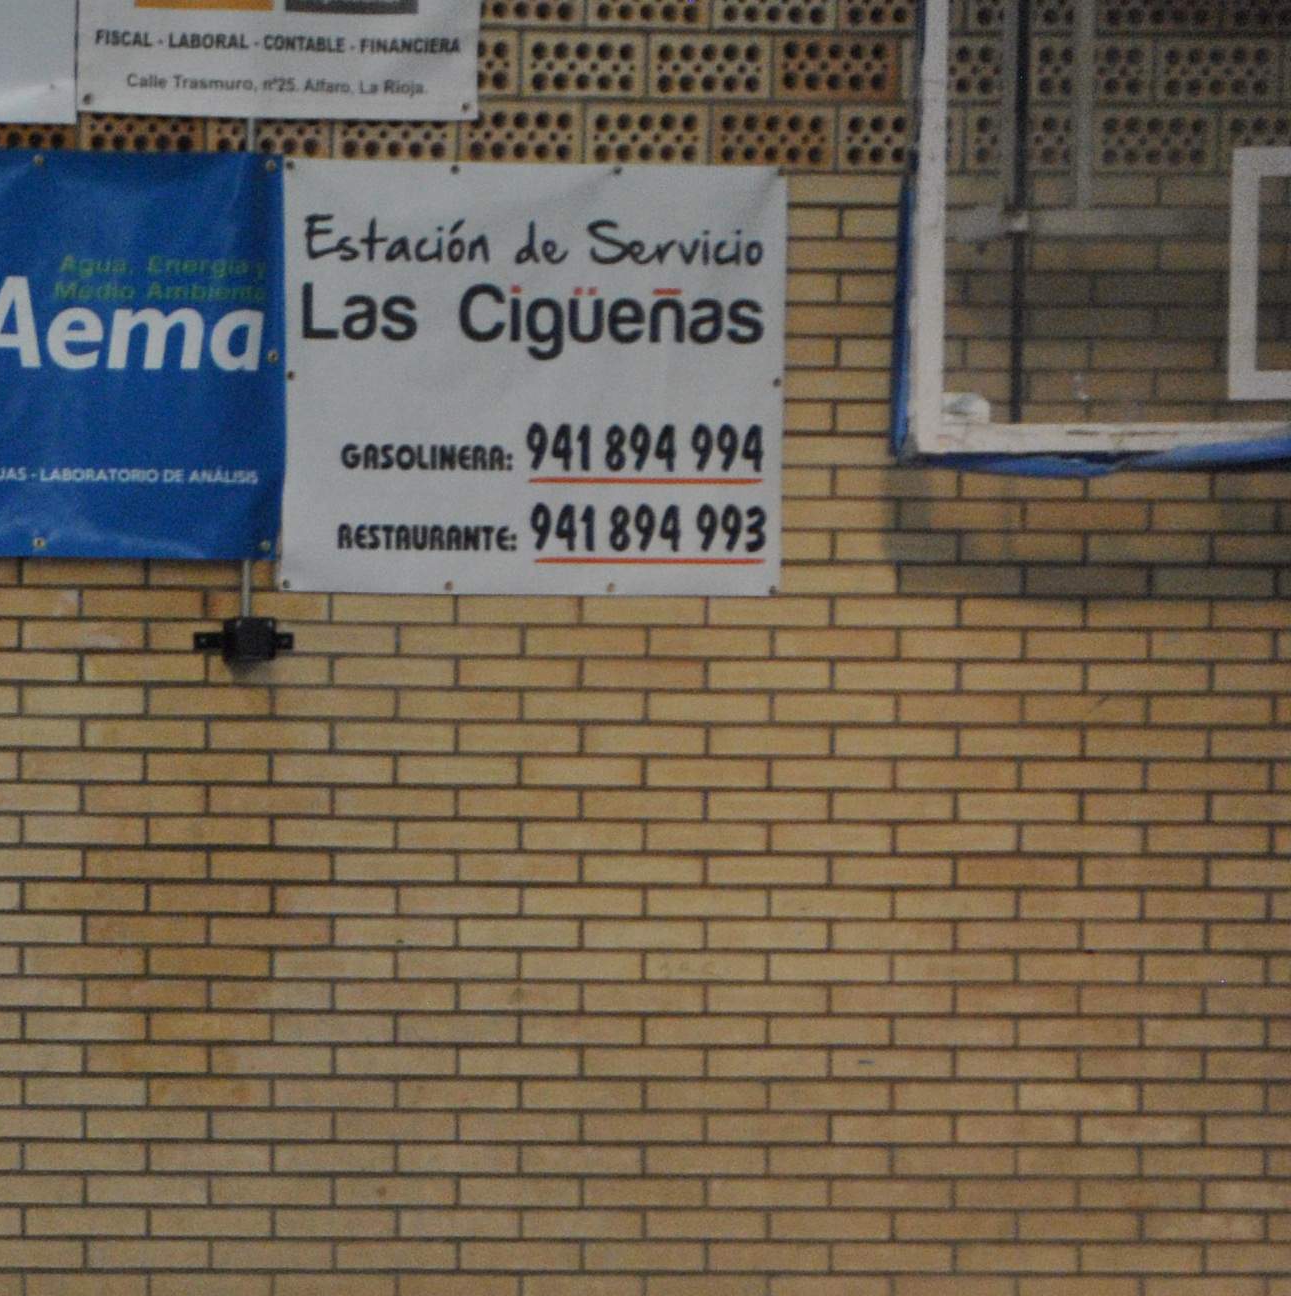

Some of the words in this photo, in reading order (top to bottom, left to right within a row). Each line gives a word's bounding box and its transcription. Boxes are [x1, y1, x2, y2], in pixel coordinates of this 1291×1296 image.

[94, 28, 153, 48] FISCAL
[168, 31, 250, 50] LABORAL
[263, 33, 346, 54] CONTABLE
[359, 36, 462, 55] FINANCIERA
[126, 72, 168, 89] Calle
[173, 74, 258, 93] Trasmuro,
[359, 79, 379, 95] La
[304, 212, 491, 264] Estación
[514, 219, 569, 266] de
[586, 219, 765, 267] Servicio
[53, 280, 137, 301] Medio
[300, 281, 418, 341] Las
[458, 282, 765, 362] Cigüeñas
[340, 442, 514, 472] GASOLINERA:
[526, 421, 592, 473] 941
[604, 422, 676, 473] 894
[690, 423, 765, 474] 994
[39, 466, 159, 483] LABORATORIO
[162, 467, 185, 484] DE
[336, 522, 517, 552] RESTAURANTE:
[529, 501, 596, 553] 941
[608, 503, 681, 553] 894
[696, 503, 768, 554] 993
